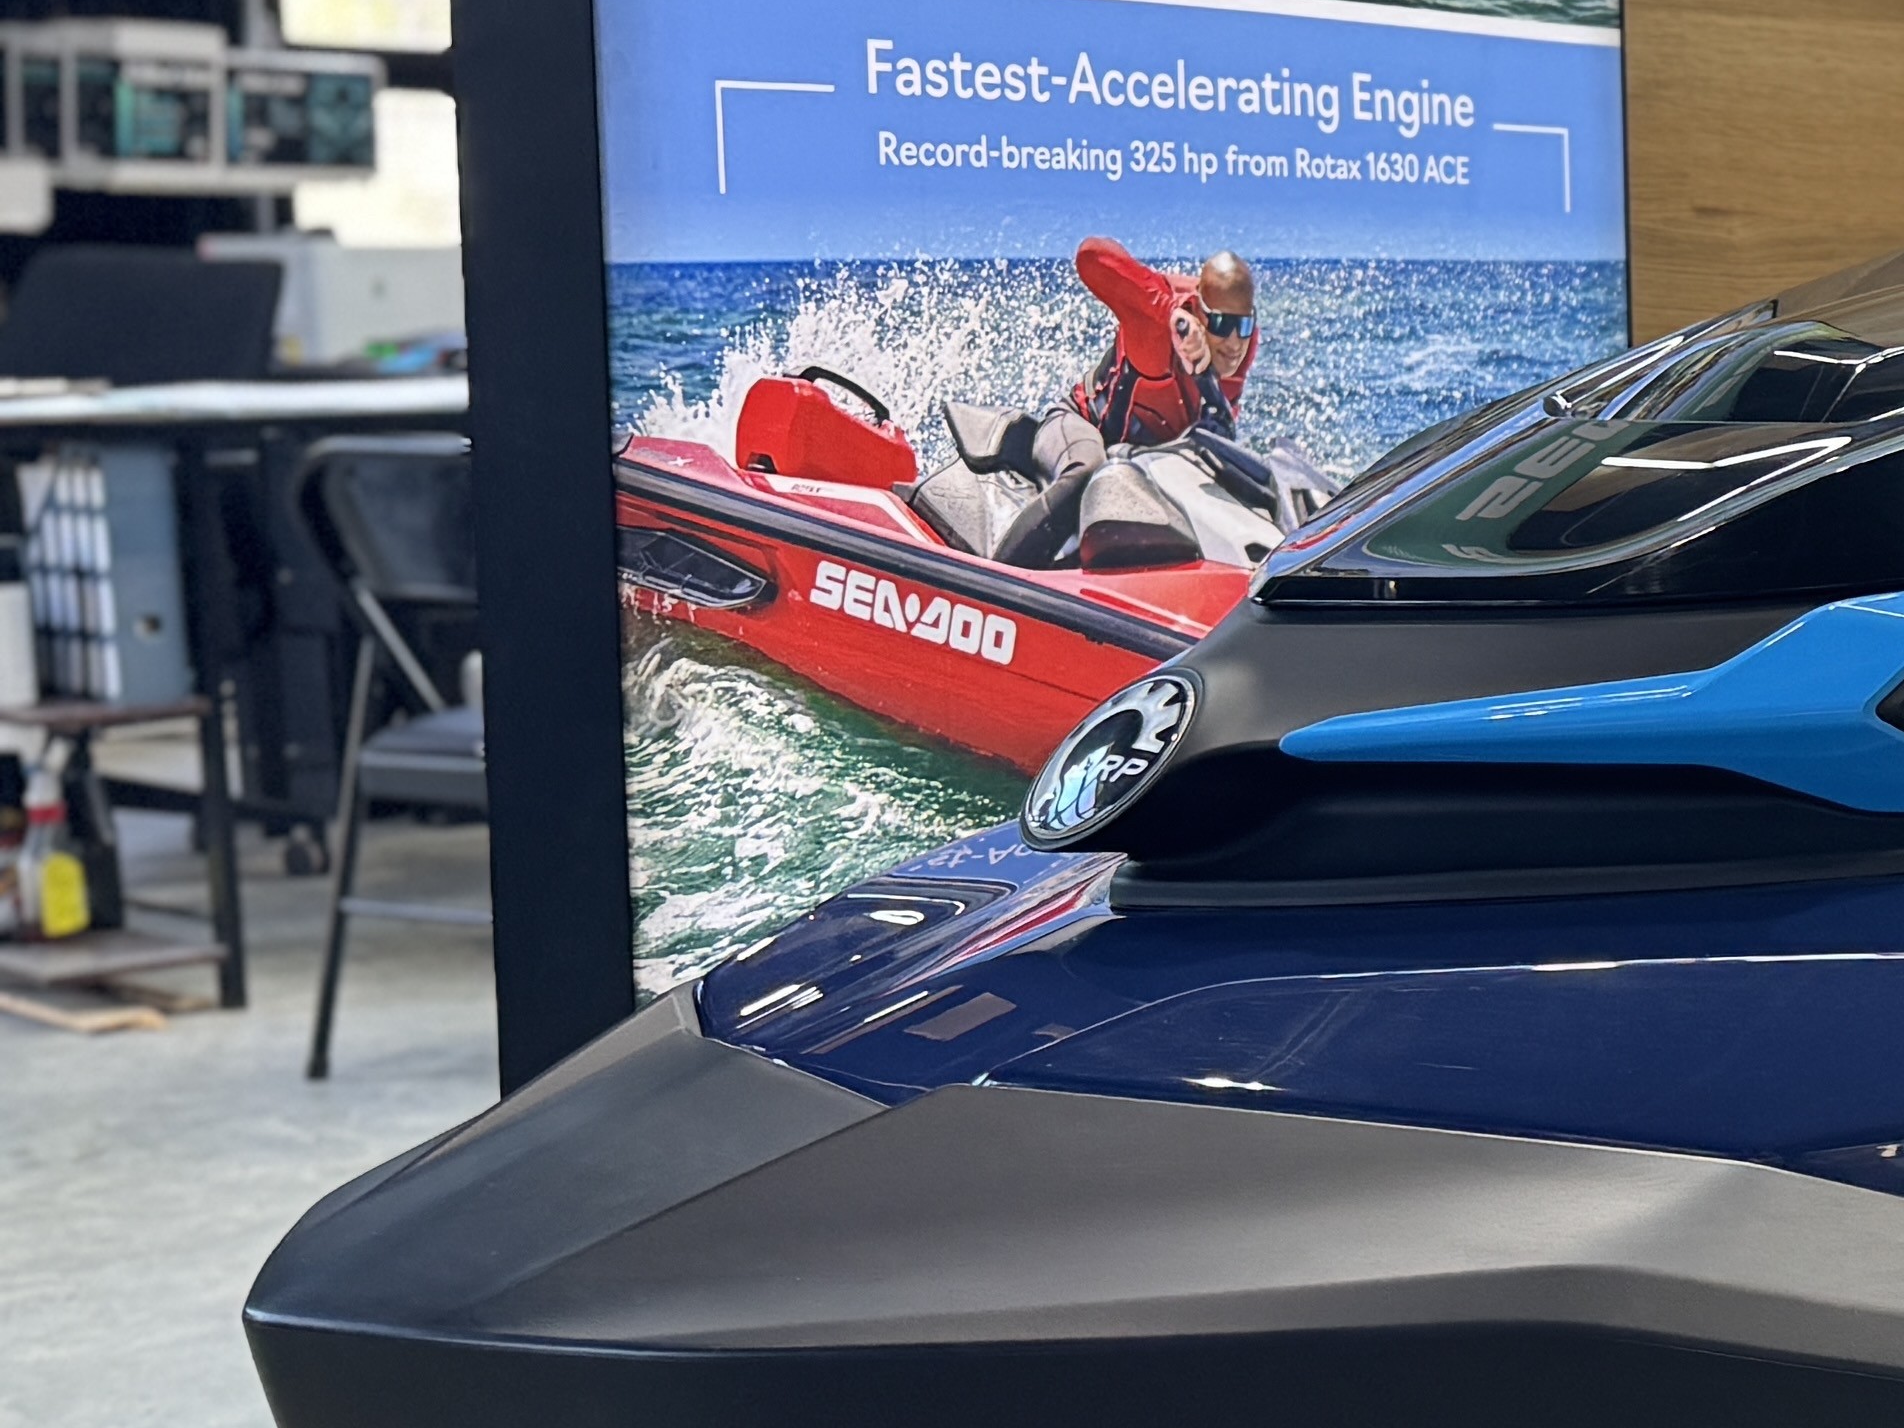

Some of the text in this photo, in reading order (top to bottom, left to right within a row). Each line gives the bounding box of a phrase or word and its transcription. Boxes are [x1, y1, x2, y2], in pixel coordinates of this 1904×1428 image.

[866, 39, 1475, 138] Fastest-Accelerating Engine
[878, 130, 1470, 185] Record-breaking 325 hp from Rotax 1630 ACE
